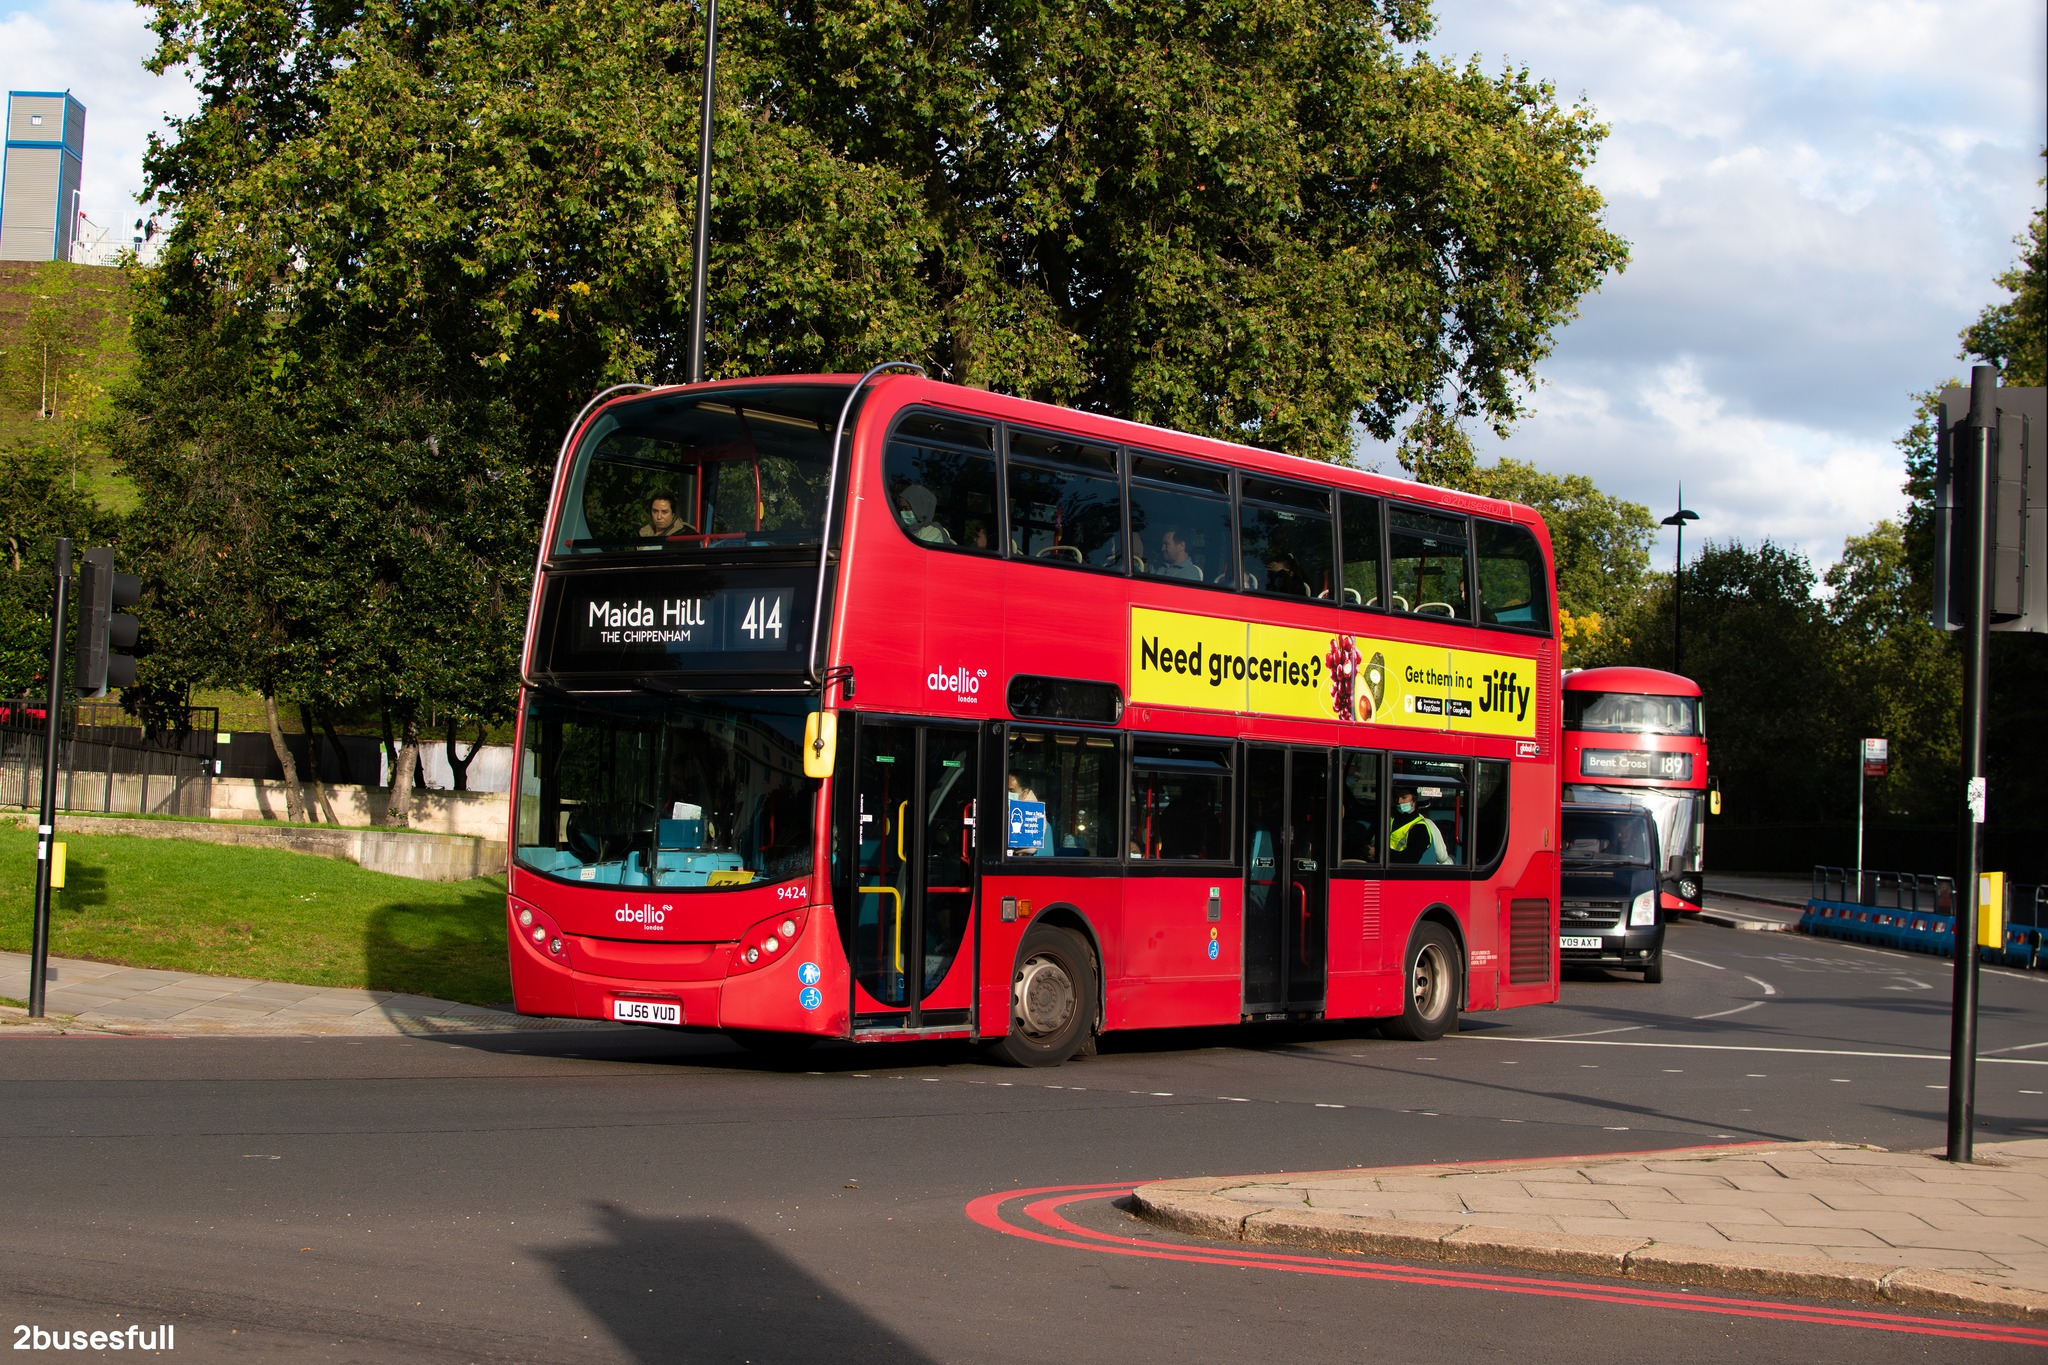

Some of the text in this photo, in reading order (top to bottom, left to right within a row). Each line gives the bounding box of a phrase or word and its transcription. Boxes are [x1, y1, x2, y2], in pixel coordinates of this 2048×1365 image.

[588, 598, 706, 627] Maida Hill
[741, 596, 783, 640] 414
[600, 630, 691, 643] THE CHIPPENHAM
[1141, 635, 1322, 688] Need groceries?
[927, 665, 979, 694] abellio
[1405, 665, 1473, 689] Get them in a
[957, 694, 978, 703] london
[1479, 669, 1531, 722] Jiffy
[1423, 704, 1441, 713] App Store
[1452, 706, 1464, 715] Google
[1590, 757, 1647, 769] Brent Cross
[1661, 757, 1683, 773] 189
[777, 886, 807, 900] 9424
[615, 903, 665, 924] abellio
[1581, 938, 1598, 947] AXT
[619, 1003, 675, 1021] LJ56 VUD
